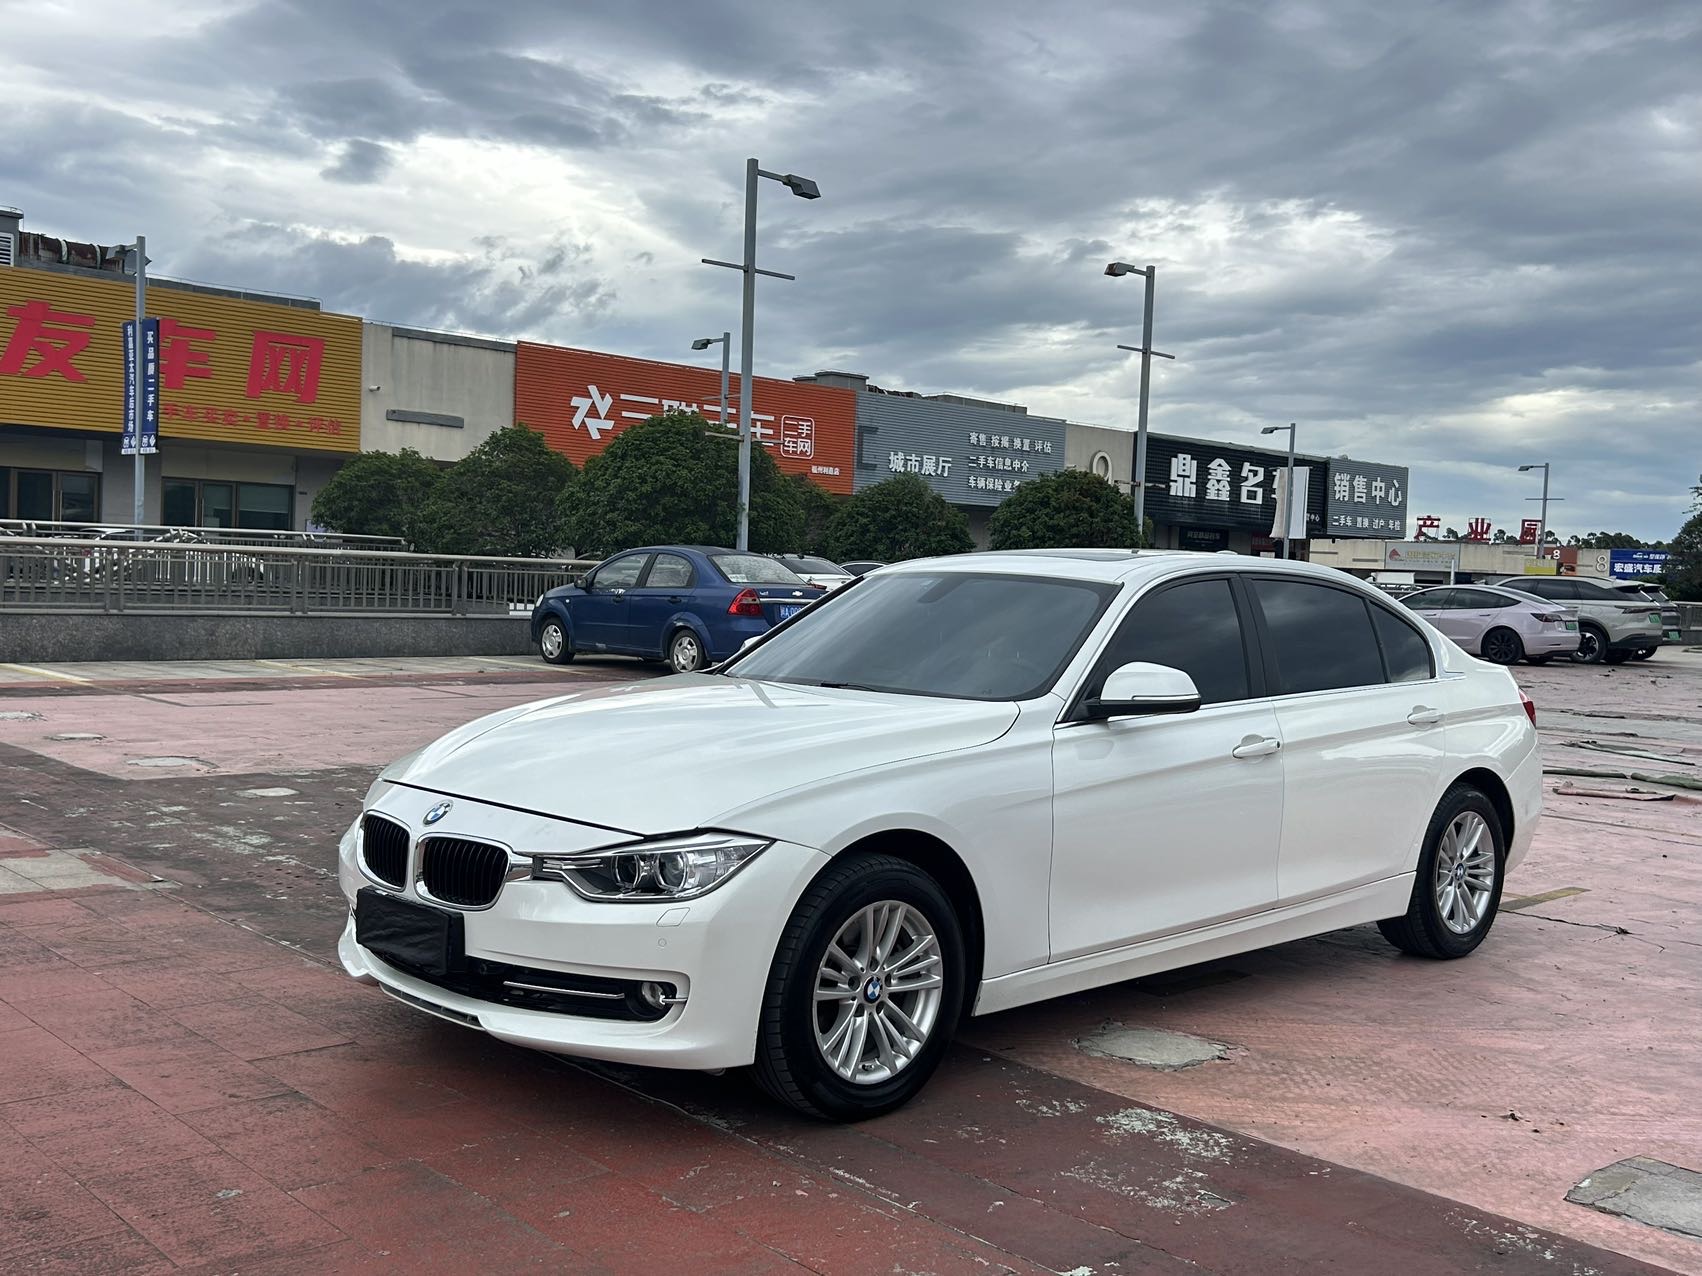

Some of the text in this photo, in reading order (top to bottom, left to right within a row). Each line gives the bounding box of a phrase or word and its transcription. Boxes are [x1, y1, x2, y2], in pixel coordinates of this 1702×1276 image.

[969, 432, 1052, 454] 寄售 按揭 换置 评估
[888, 451, 952, 477] 城市展厅
[968, 455, 1030, 473] 二手车信息中介
[1334, 472, 1402, 506] 销售中心
[1332, 515, 1401, 531] 二手车 置换 过户 年检
[1596, 555, 1608, 572] 8
